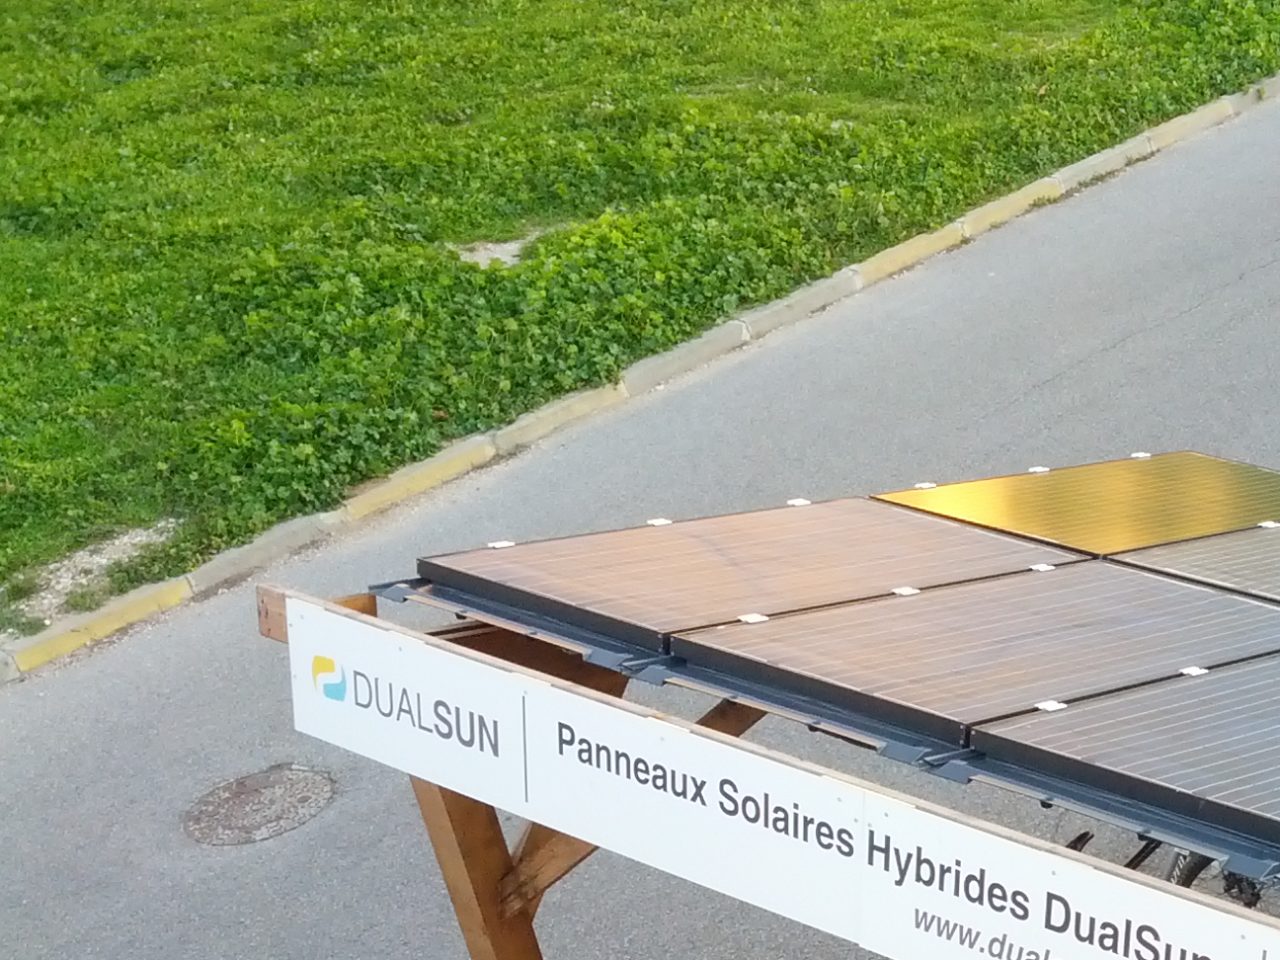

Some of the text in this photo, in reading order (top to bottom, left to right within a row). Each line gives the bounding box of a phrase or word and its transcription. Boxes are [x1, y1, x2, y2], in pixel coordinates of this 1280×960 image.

[353, 670, 499, 758] DUALSUN
[557, 721, 707, 807] Panneaux
[718, 778, 854, 858] Solaires
[867, 829, 1030, 921] Hybrides
